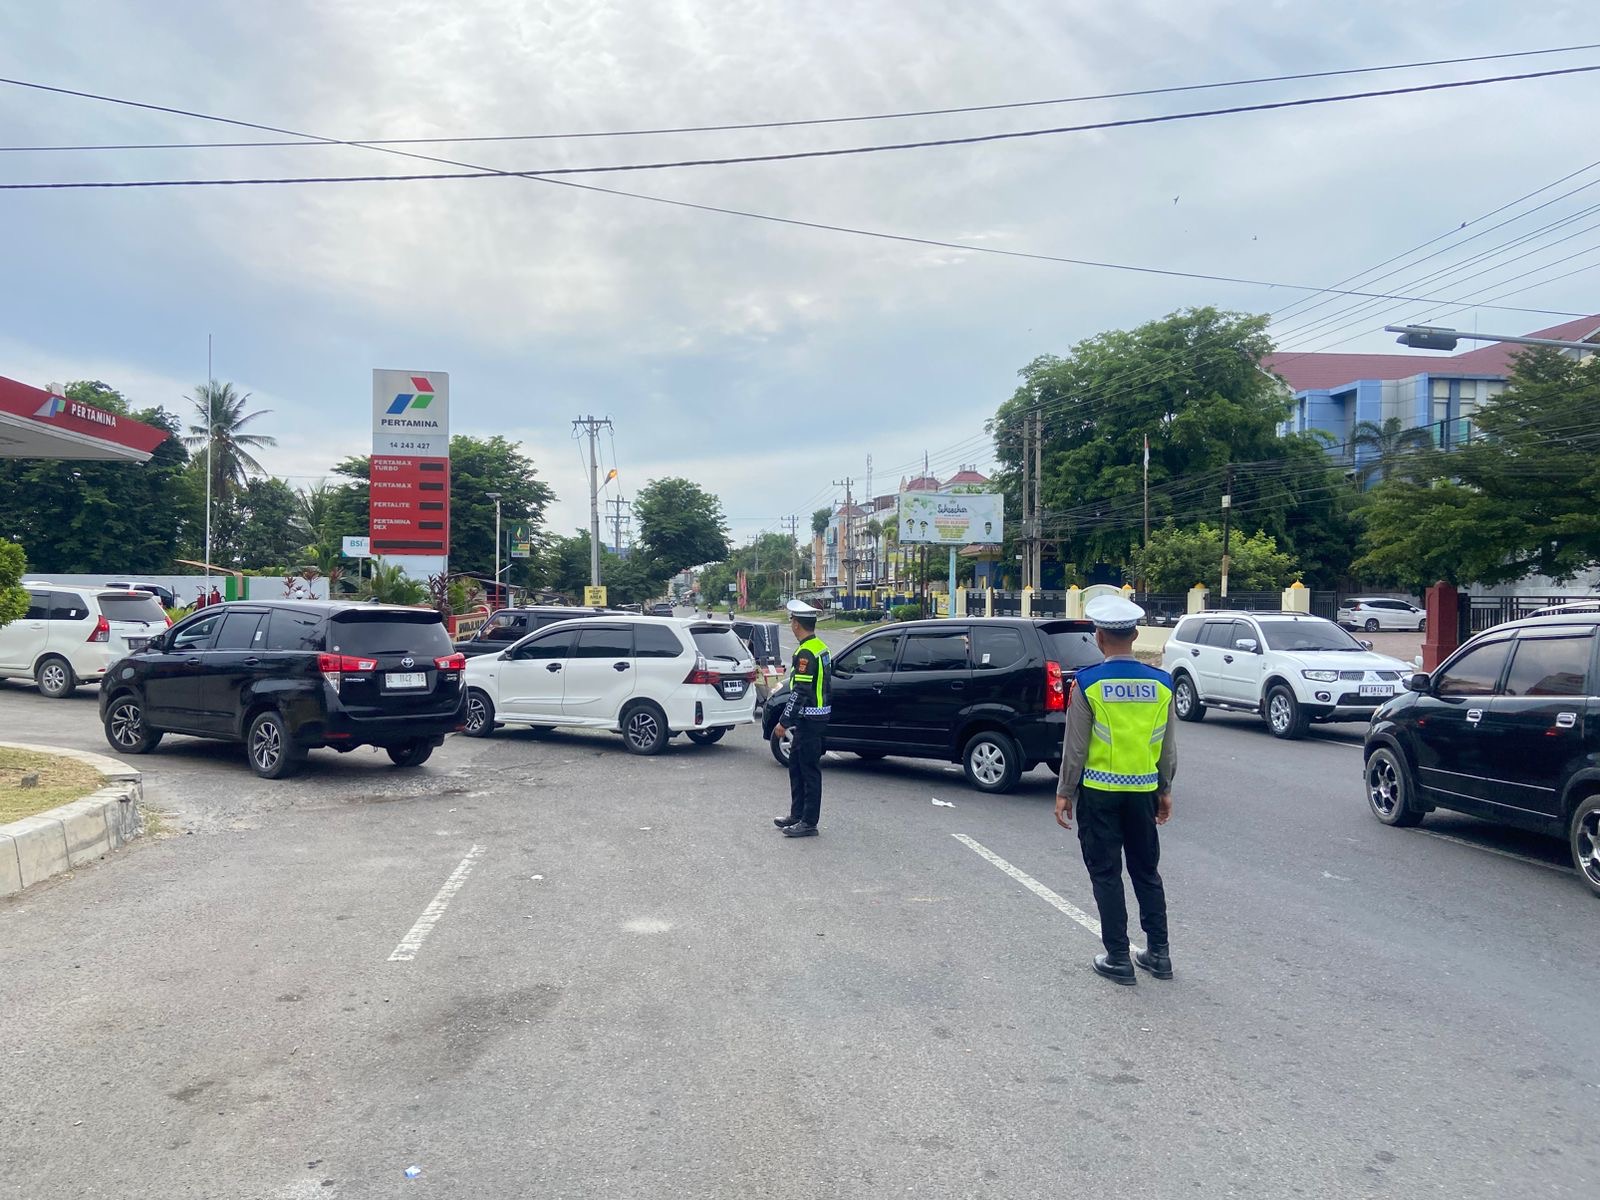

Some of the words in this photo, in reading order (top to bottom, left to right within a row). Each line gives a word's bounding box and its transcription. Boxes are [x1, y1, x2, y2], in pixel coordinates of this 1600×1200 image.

[71, 403, 117, 428] PERTAMINA
[381, 418, 439, 428] PERTAMINA
[1103, 684, 1156, 699] POLISI
[784, 691, 799, 717] POLISI
